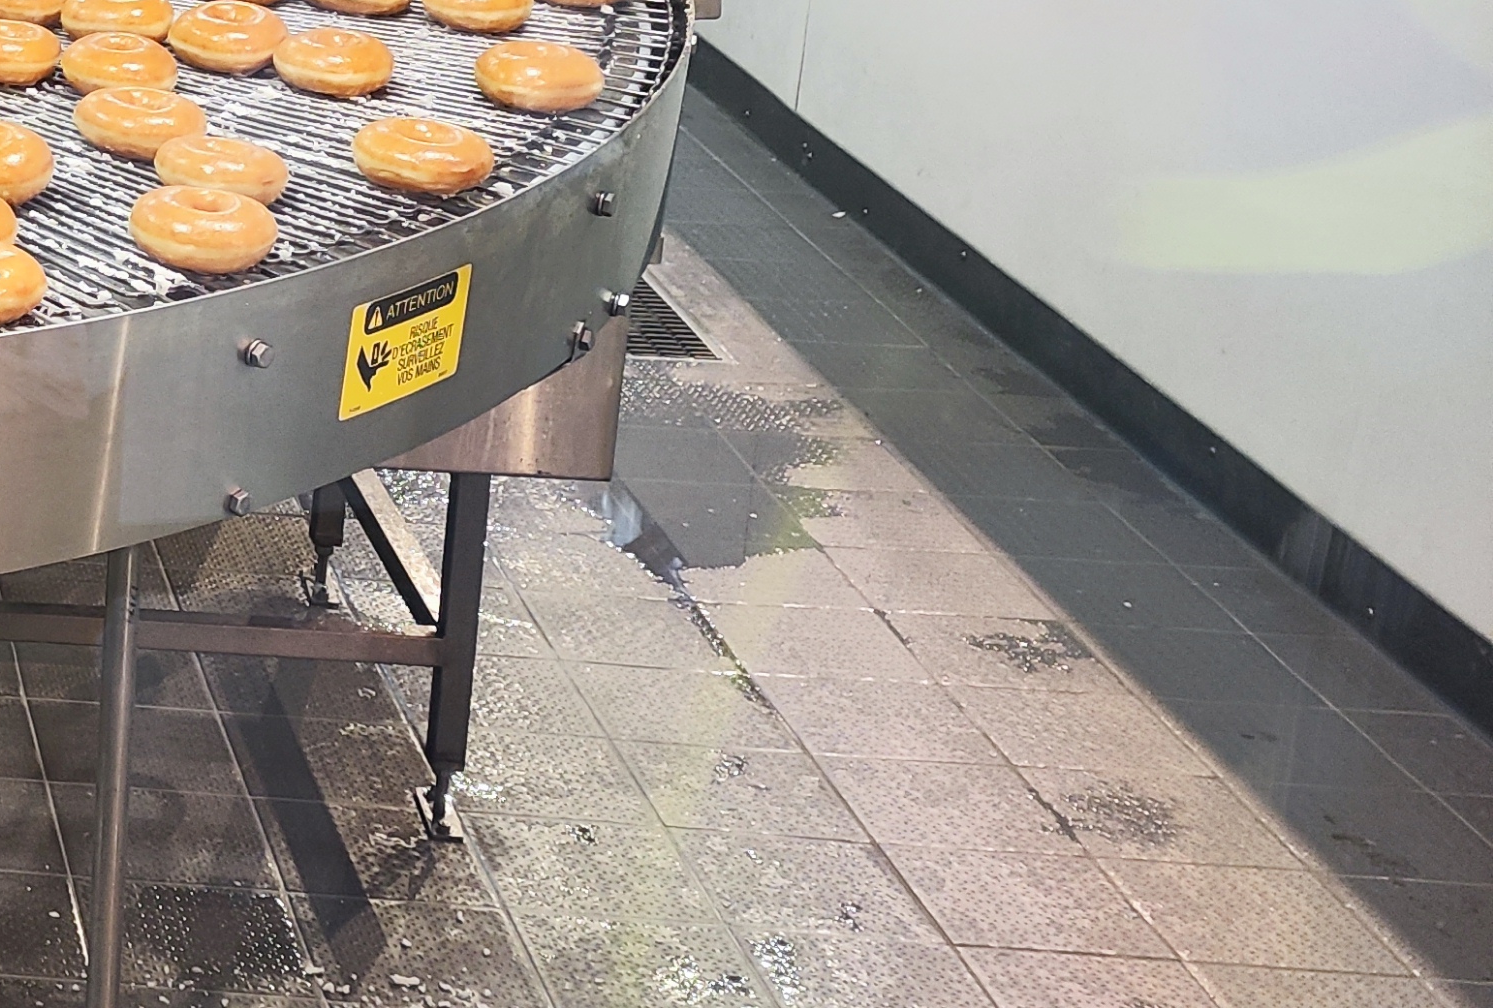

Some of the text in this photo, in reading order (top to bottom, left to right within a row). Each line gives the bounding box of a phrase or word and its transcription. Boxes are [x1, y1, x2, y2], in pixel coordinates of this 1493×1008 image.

[386, 280, 454, 321] ATTENTION
[392, 323, 454, 360] D'ECRASEMENT
[409, 316, 439, 340] RISQUE
[397, 341, 445, 371] SURVEILLEZ
[397, 356, 441, 386] VOS MAINS
